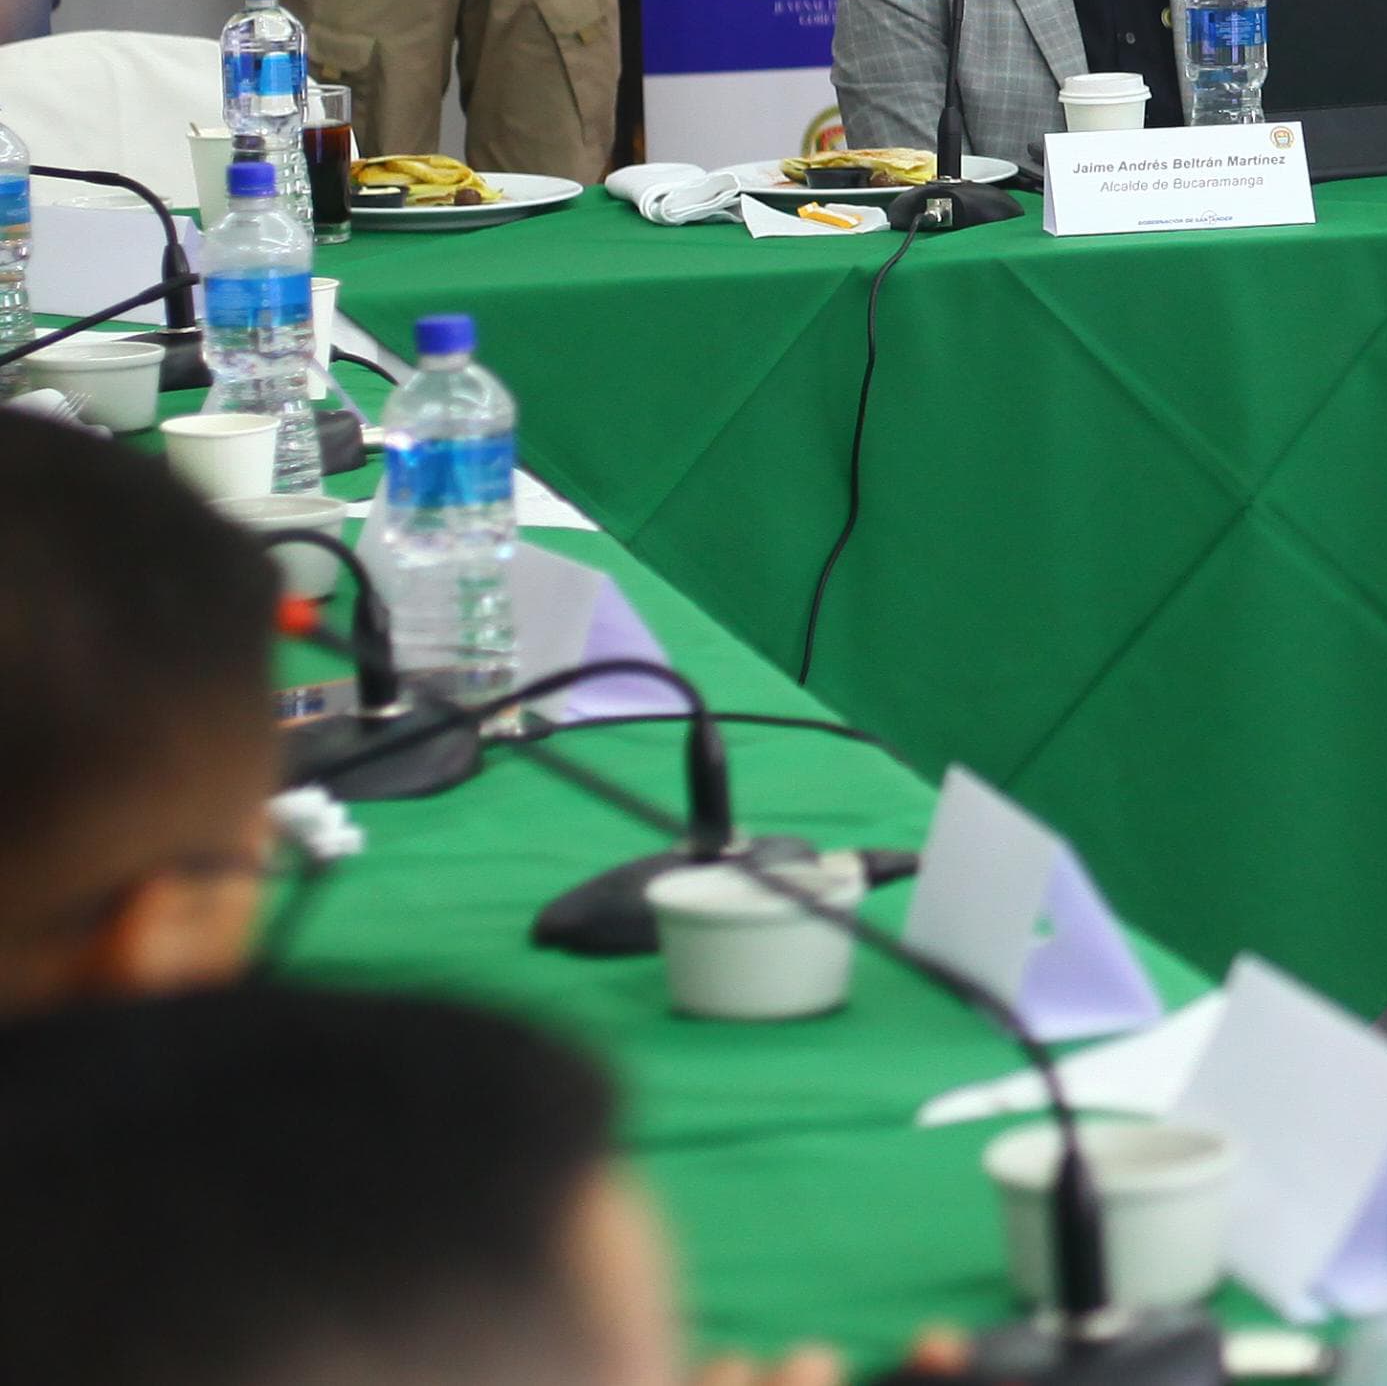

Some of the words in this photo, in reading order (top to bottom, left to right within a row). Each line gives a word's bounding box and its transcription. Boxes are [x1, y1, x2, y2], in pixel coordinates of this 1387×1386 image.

[1073, 163, 1114, 174] Jaime
[1118, 160, 1167, 172] Andrés
[1173, 157, 1222, 170] Beltrán
[1227, 155, 1285, 167] Martínez
[1100, 180, 1148, 192] Alcalde
[1153, 179, 1169, 191] de
[1173, 175, 1263, 190] Bucaramanga
